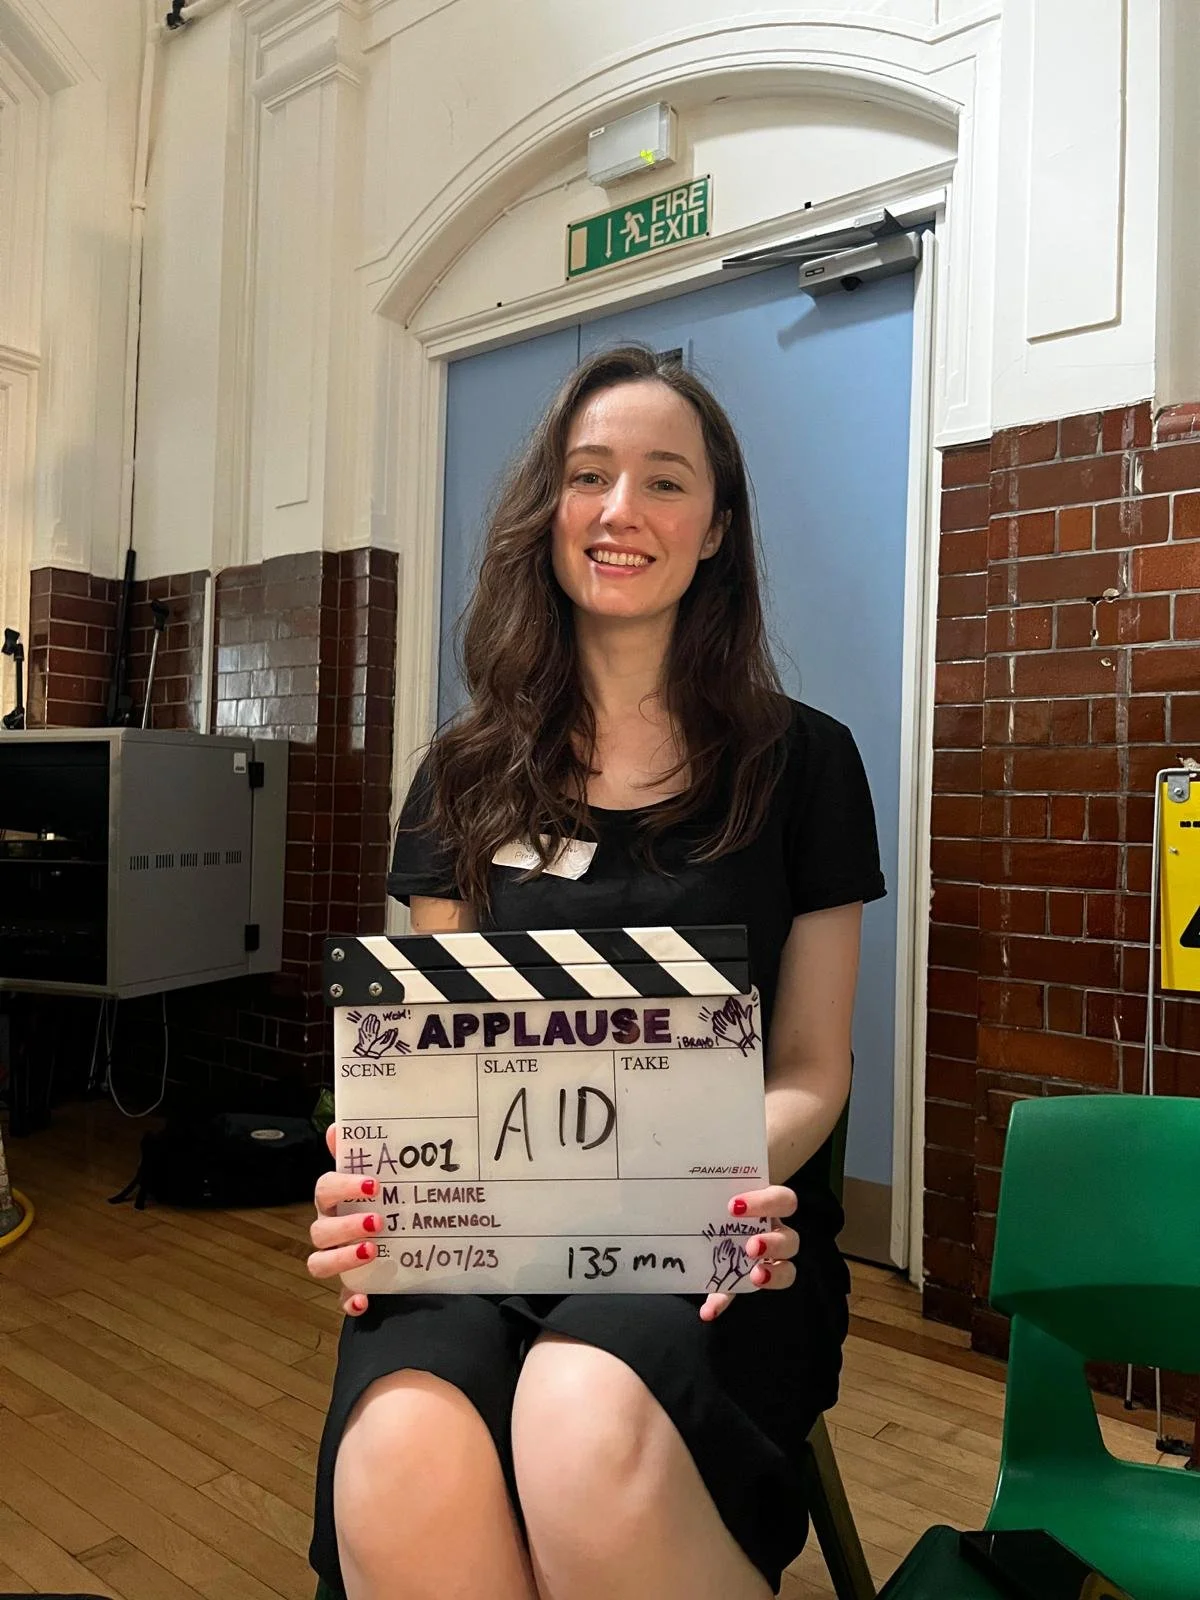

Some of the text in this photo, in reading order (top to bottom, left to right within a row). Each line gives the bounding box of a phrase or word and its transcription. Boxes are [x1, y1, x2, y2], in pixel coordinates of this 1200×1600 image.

[652, 181, 705, 223] FIRE
[650, 207, 705, 248] EXIT
[417, 1008, 672, 1049] APPLAUSE
[341, 1063, 397, 1078] SCENE
[483, 1058, 538, 1073] SLATE
[621, 1056, 670, 1070] TAKE
[342, 1126, 388, 1139] ROLL
[344, 1138, 461, 1174] #A001
[689, 1166, 759, 1174] PANAVISION
[383, 1185, 405, 1205] M.
[386, 1212, 502, 1231] J. ARMENGOL
[400, 1244, 499, 1271] 01/07/23
[568, 1246, 621, 1279] 135
